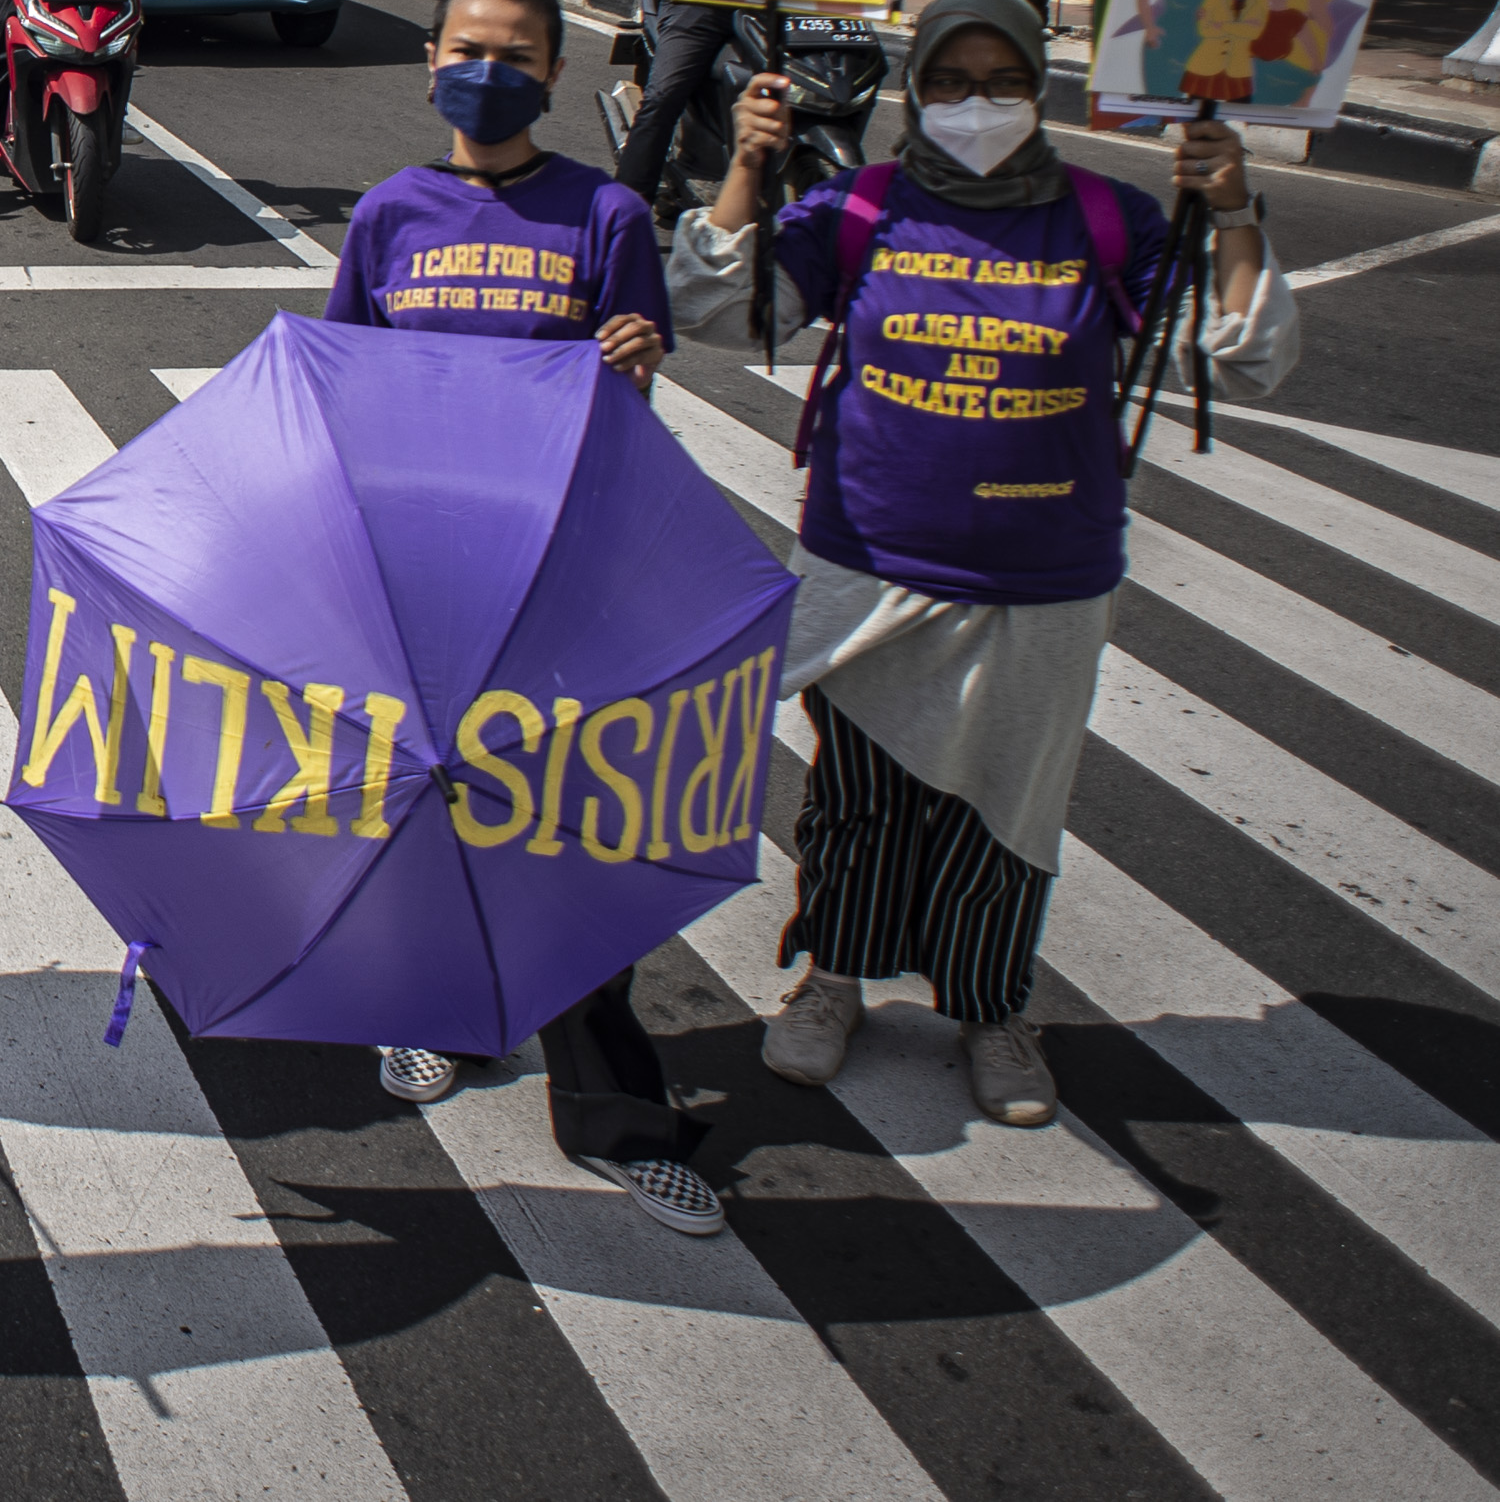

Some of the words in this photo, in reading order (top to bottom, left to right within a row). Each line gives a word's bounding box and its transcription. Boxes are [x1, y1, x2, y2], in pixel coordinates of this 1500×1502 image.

[799, 19, 835, 31] 4355
[411, 252, 423, 278] I
[424, 243, 486, 277] CARE
[486, 244, 534, 278] FOR
[539, 250, 575, 284] US
[872, 248, 972, 280] WOMEN
[393, 287, 436, 311] CARE
[437, 287, 476, 309] FOR
[480, 288, 519, 310] THE
[882, 313, 1069, 355] OLIGARCHY
[945, 353, 1000, 380] AND
[861, 364, 987, 418] CLIMATE
[989, 387, 1087, 419] CRISIS
[973, 480, 1075, 498] GREENPEACE
[22, 588, 406, 839] IKLIM
[448, 647, 777, 863] KRISIS
